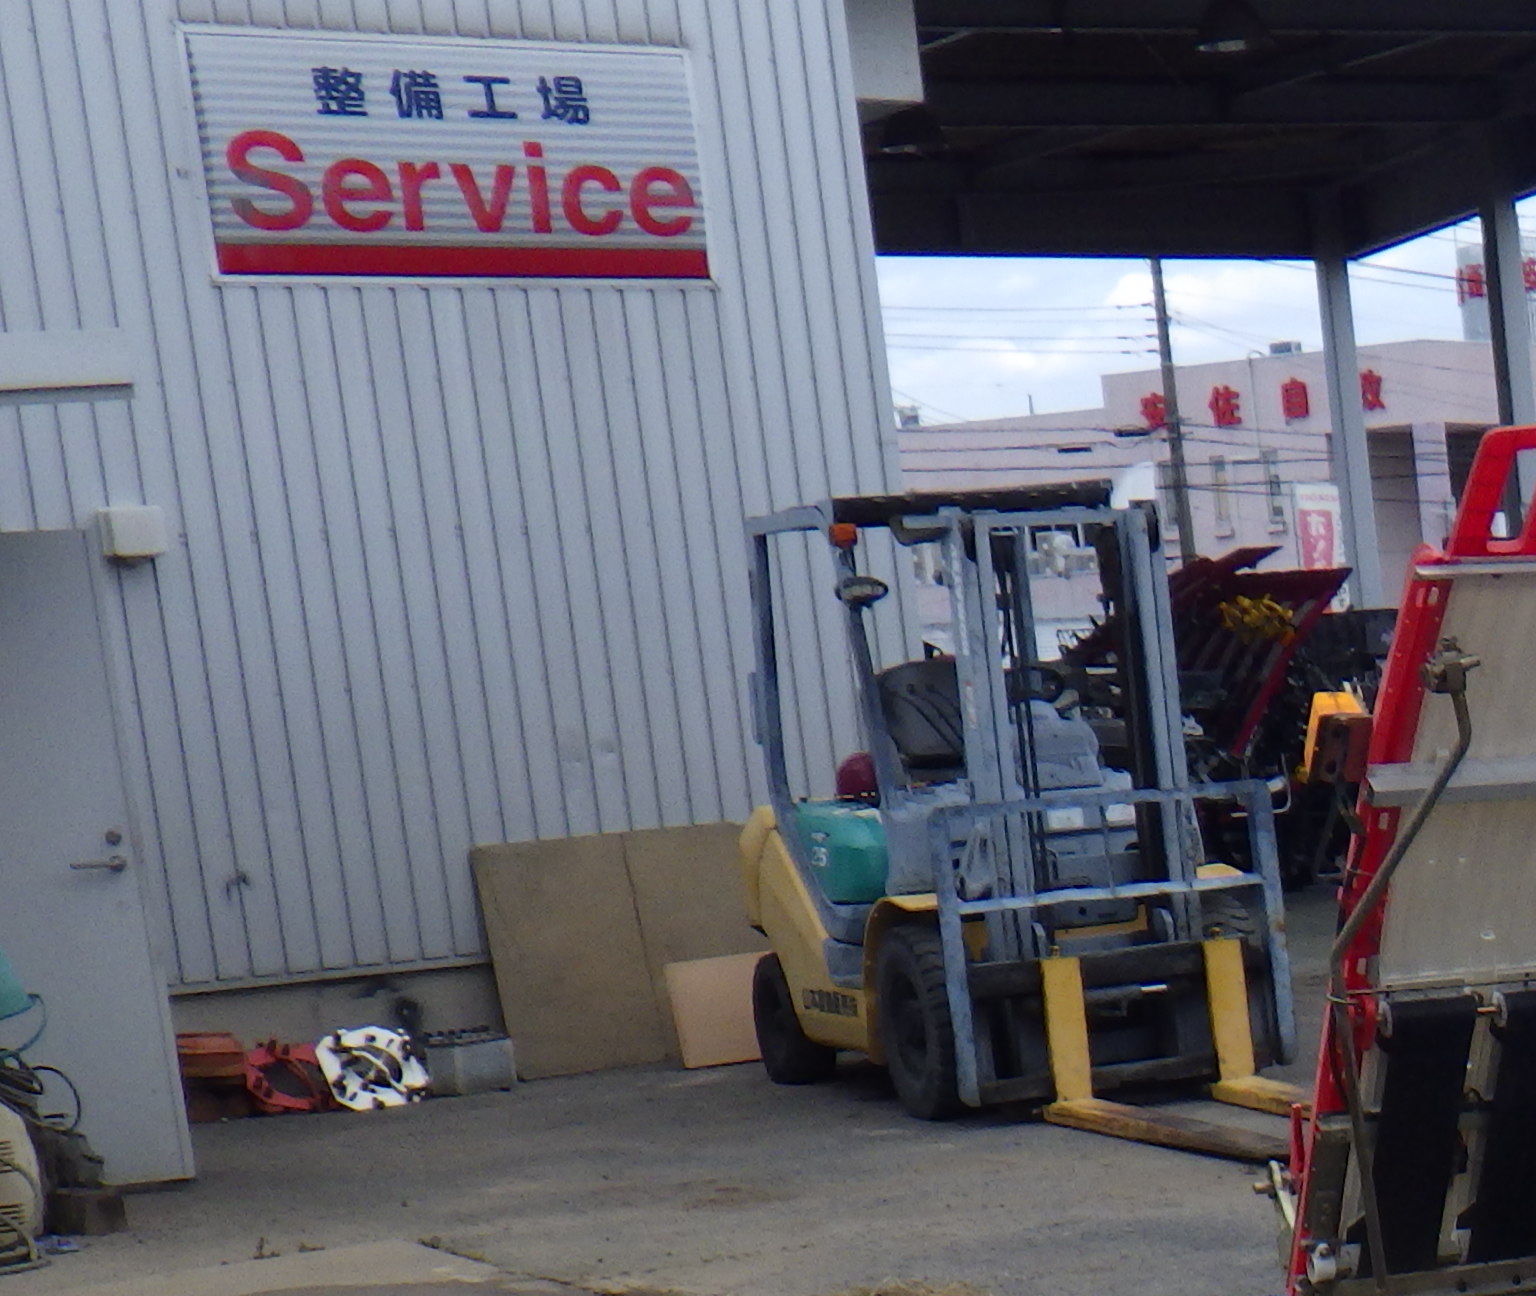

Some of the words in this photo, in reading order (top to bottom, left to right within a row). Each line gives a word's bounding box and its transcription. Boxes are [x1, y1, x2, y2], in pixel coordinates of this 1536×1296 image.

[311, 66, 591, 125] 整備工場
[226, 129, 696, 237] Service
